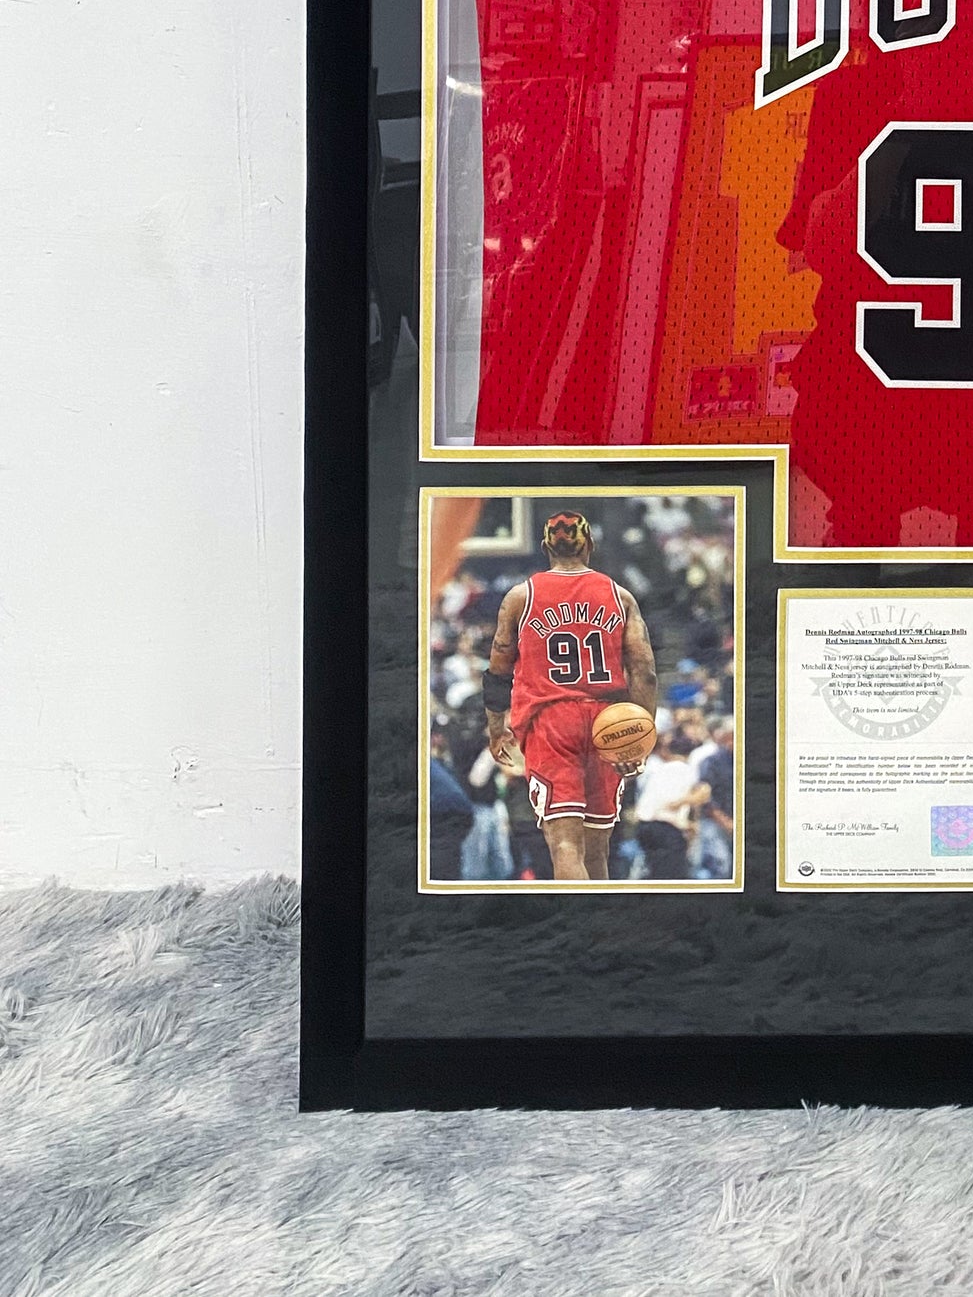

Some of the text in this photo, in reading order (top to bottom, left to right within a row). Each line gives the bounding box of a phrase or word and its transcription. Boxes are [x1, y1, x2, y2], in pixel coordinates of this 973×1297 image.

[528, 602, 621, 638] RODMAN
[546, 630, 611, 685] 91
[602, 722, 644, 744] SPALDING
